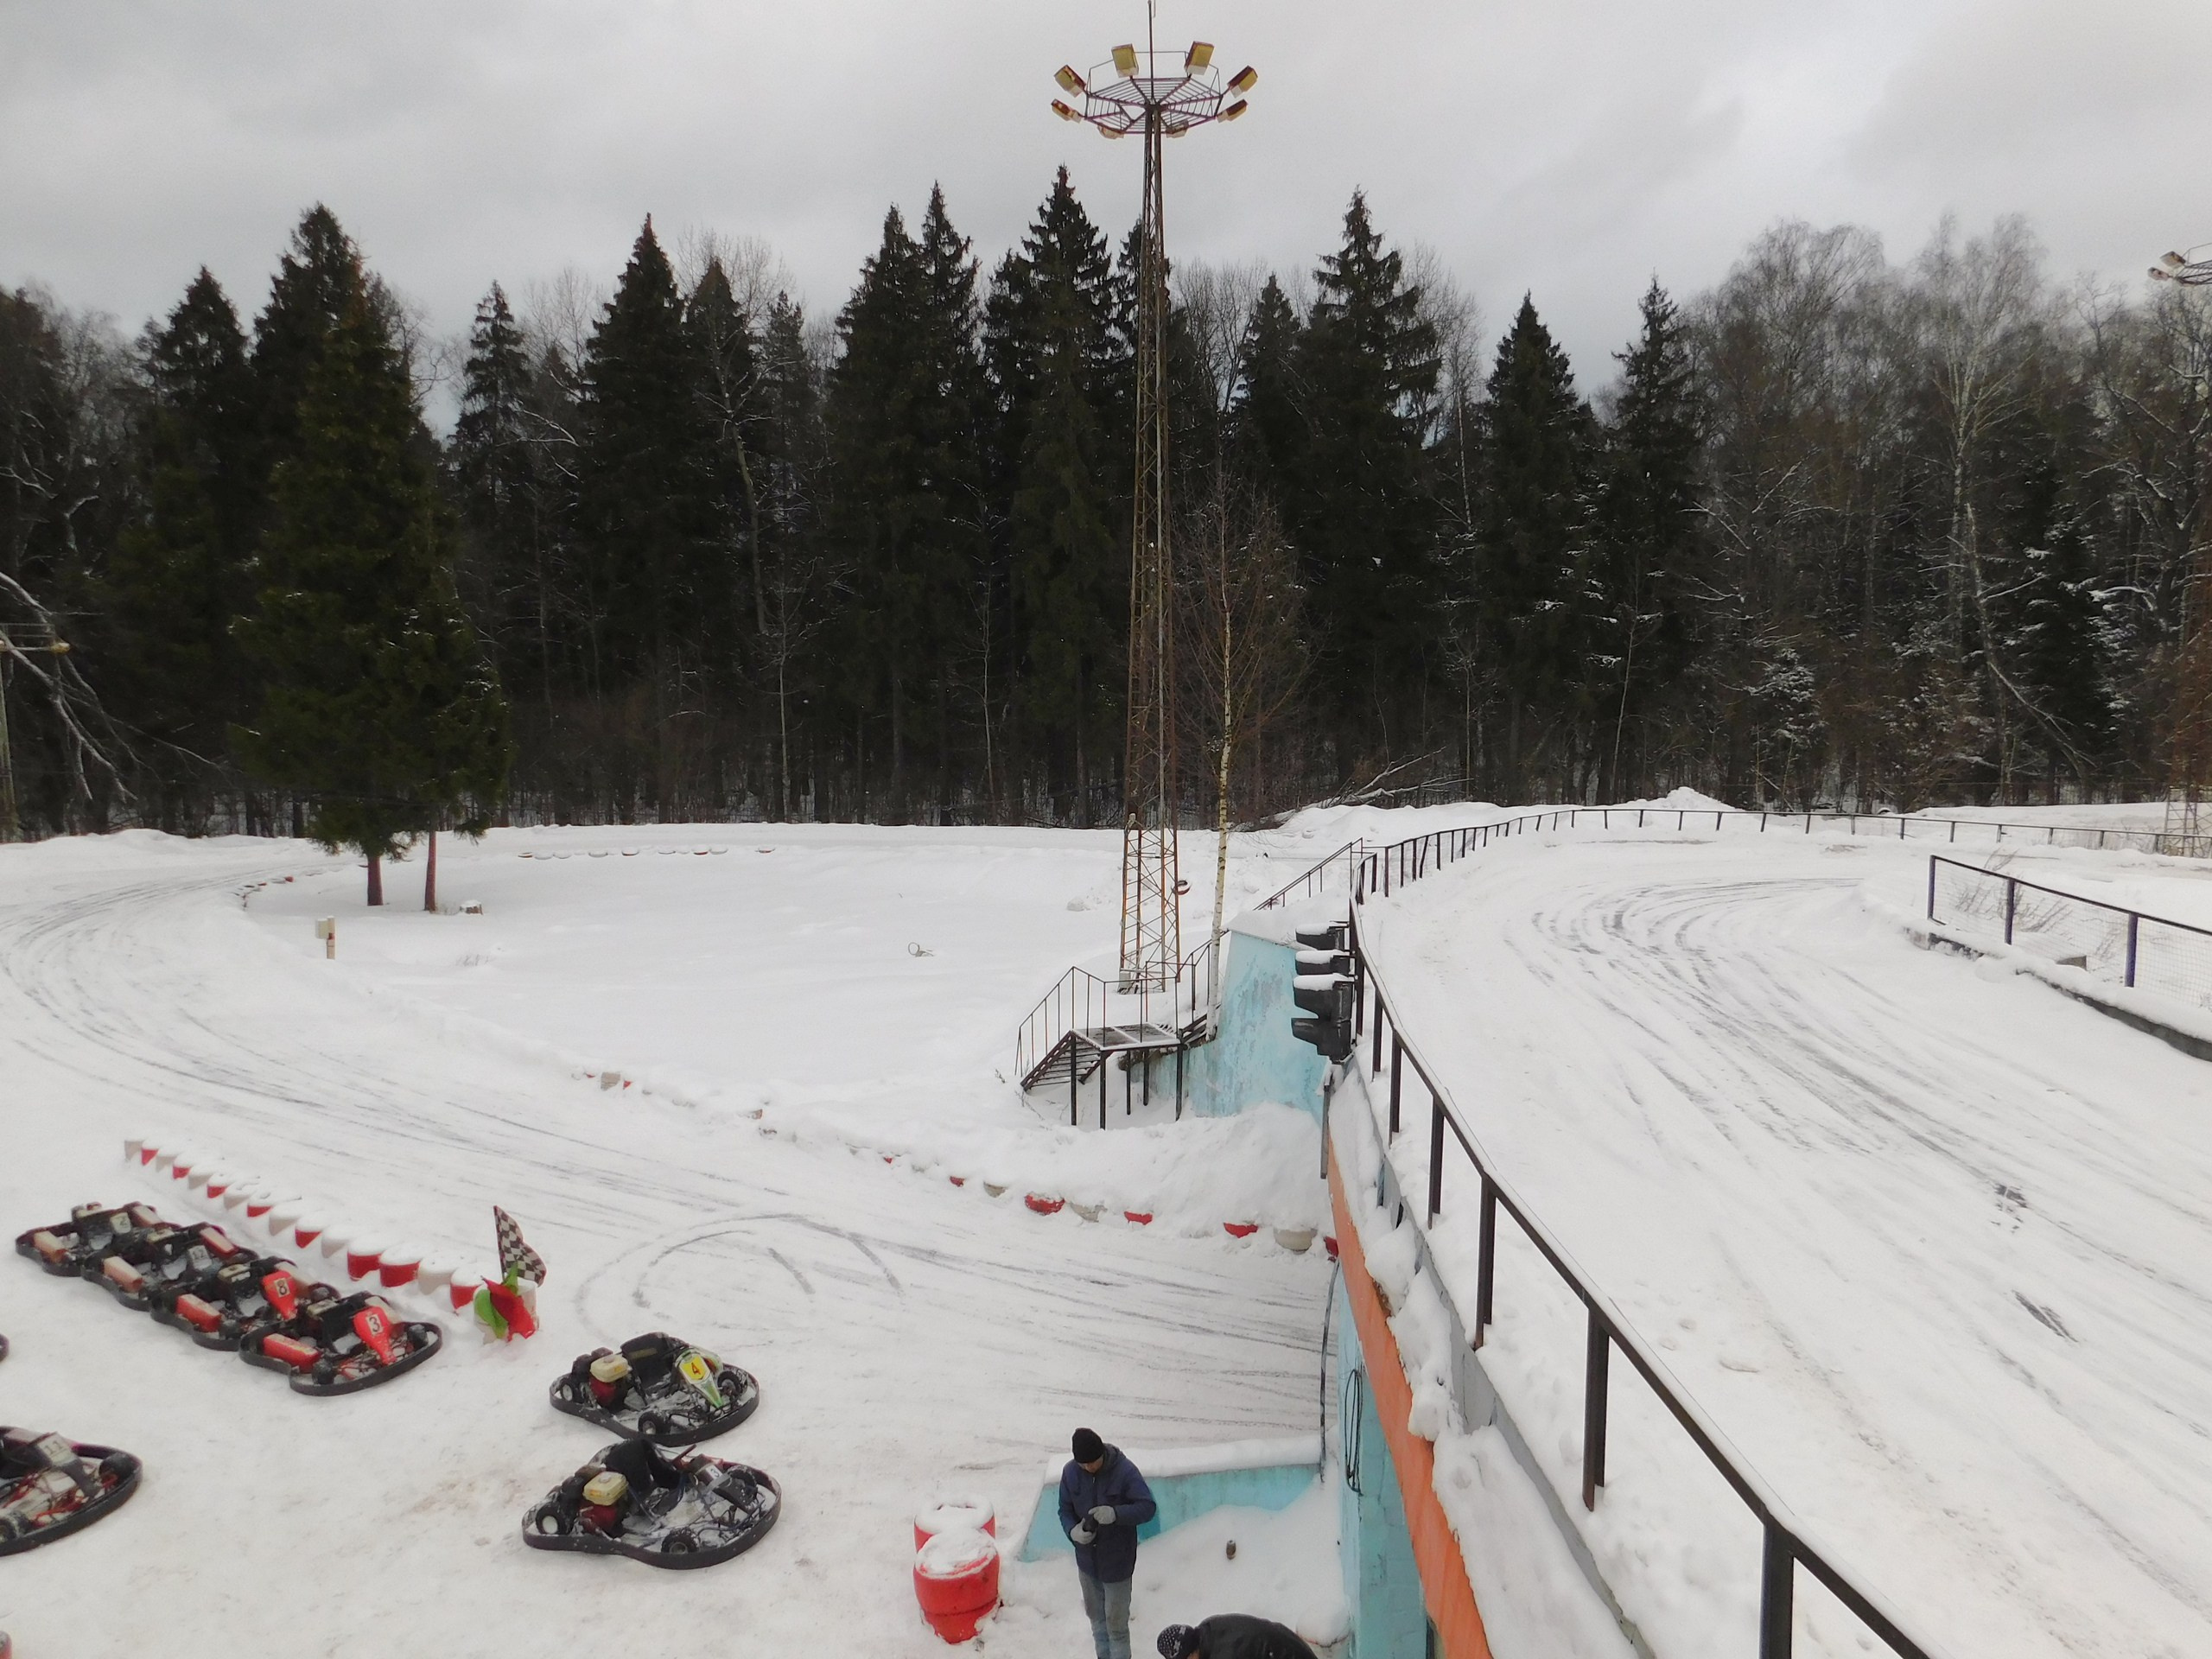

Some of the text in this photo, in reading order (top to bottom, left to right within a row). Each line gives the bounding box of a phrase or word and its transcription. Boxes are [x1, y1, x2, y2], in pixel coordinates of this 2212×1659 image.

[276, 1280, 287, 1295] 8
[369, 1316, 380, 1332] 3
[690, 1362, 701, 1375] 4
